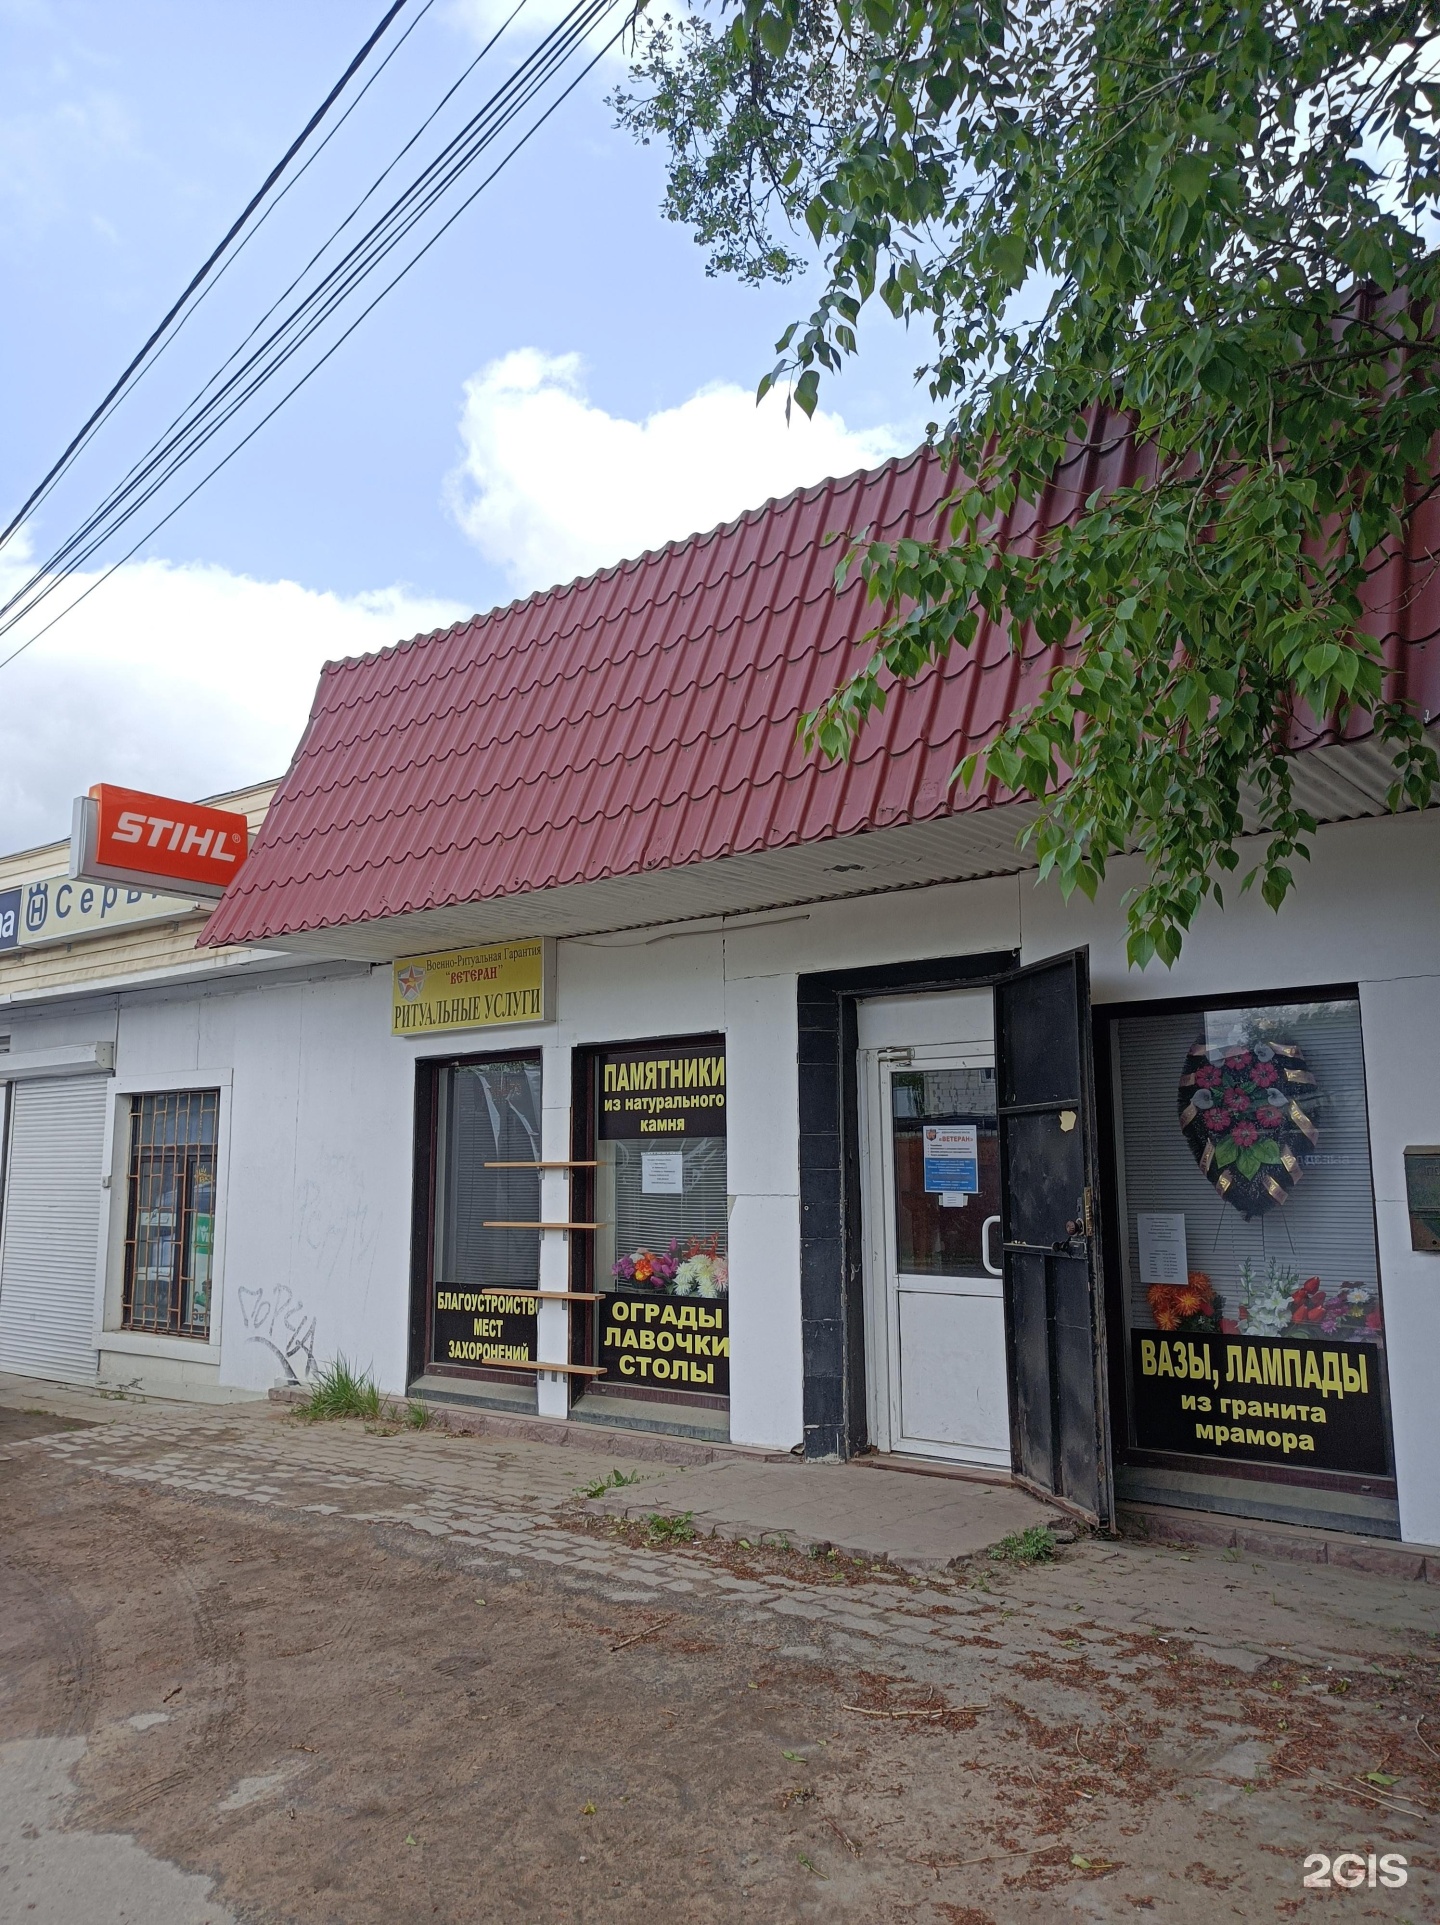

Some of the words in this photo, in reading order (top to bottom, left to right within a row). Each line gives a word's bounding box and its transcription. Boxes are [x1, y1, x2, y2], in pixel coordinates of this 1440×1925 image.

[426, 952, 502, 971] Военно-Ритуальная
[504, 946, 542, 962] Гарантия
[394, 996, 481, 1029] РИТУАЛЬНЫЕ
[484, 988, 541, 1019] УСЛУГИ
[604, 1056, 725, 1092] ПАМЯТНИКИ
[604, 1098, 621, 1111] из
[625, 1094, 725, 1113] натурального
[640, 1118, 685, 1132] камня
[473, 1318, 504, 1337] МЕСТ
[612, 1301, 723, 1330] ОГРАДЫ
[448, 1340, 529, 1361] ЗАХОРОНЕНИЙ
[604, 1327, 730, 1357] ЛАВОЧКИ
[619, 1354, 714, 1384] СТОЛЫ
[1141, 1339, 1219, 1390] ВАЗЫ,
[1226, 1344, 1369, 1399] ЛАМПАДЫ
[1181, 1394, 1212, 1411] из
[1220, 1397, 1327, 1423] гранита
[1195, 1423, 1315, 1453] мрамора
